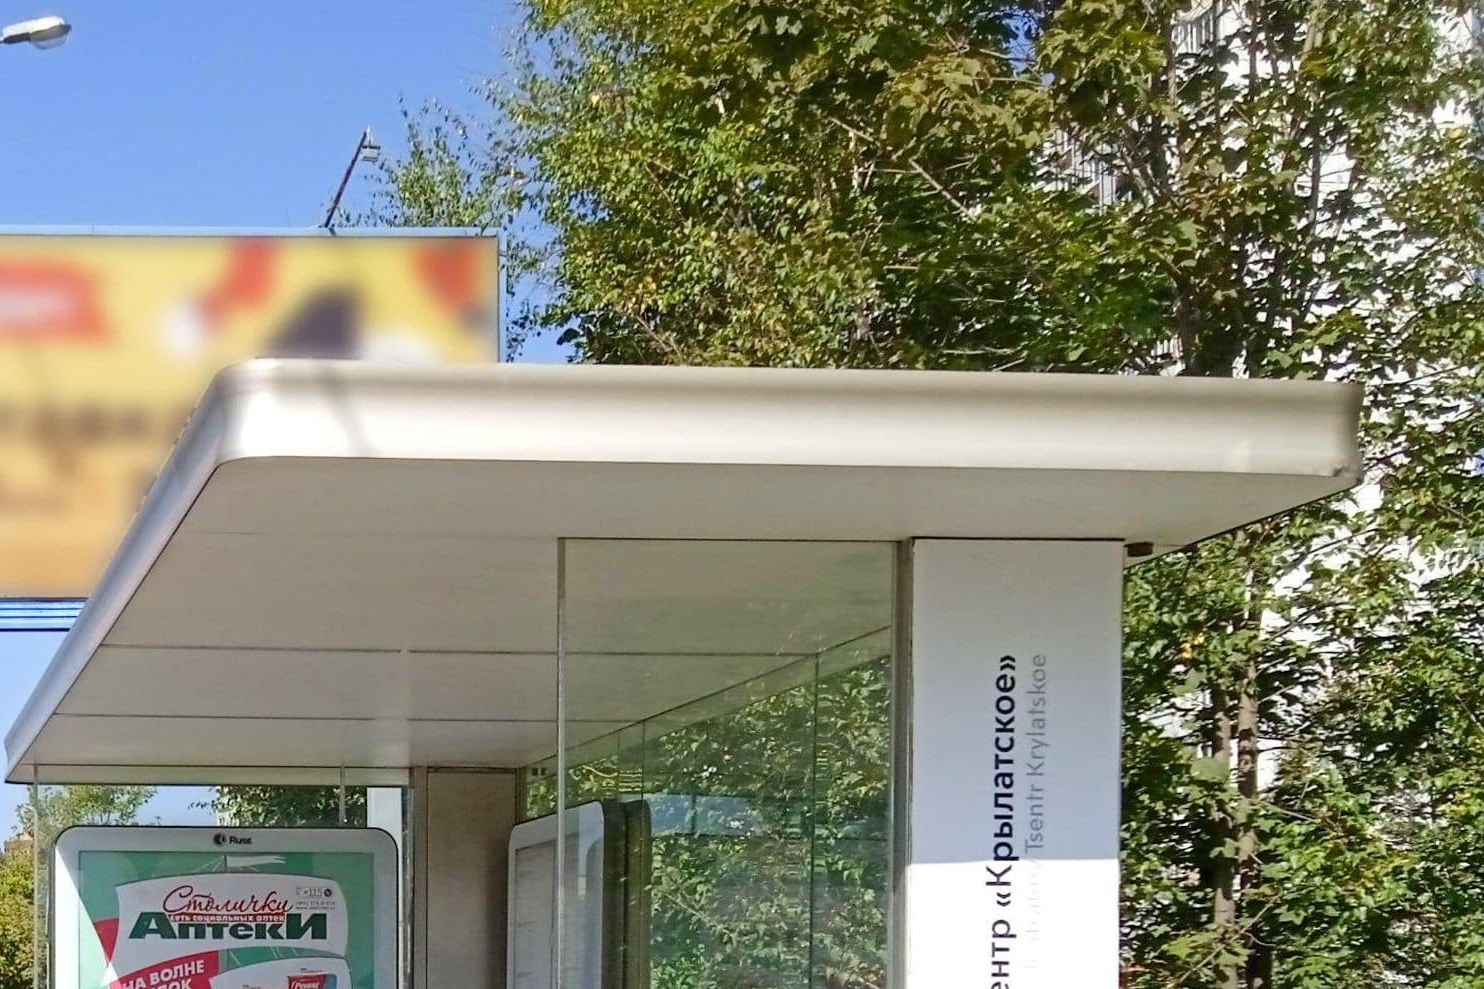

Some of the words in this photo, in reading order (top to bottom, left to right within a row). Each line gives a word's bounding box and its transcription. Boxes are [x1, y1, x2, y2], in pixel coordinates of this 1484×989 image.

[1025, 653, 1051, 776] Krylatskoe
[985, 655, 1020, 907] «Крылатское»
[1025, 783, 1045, 854] Tsentr
[163, 885, 294, 913] Столички
[149, 959, 205, 985] ВОЛНЕ
